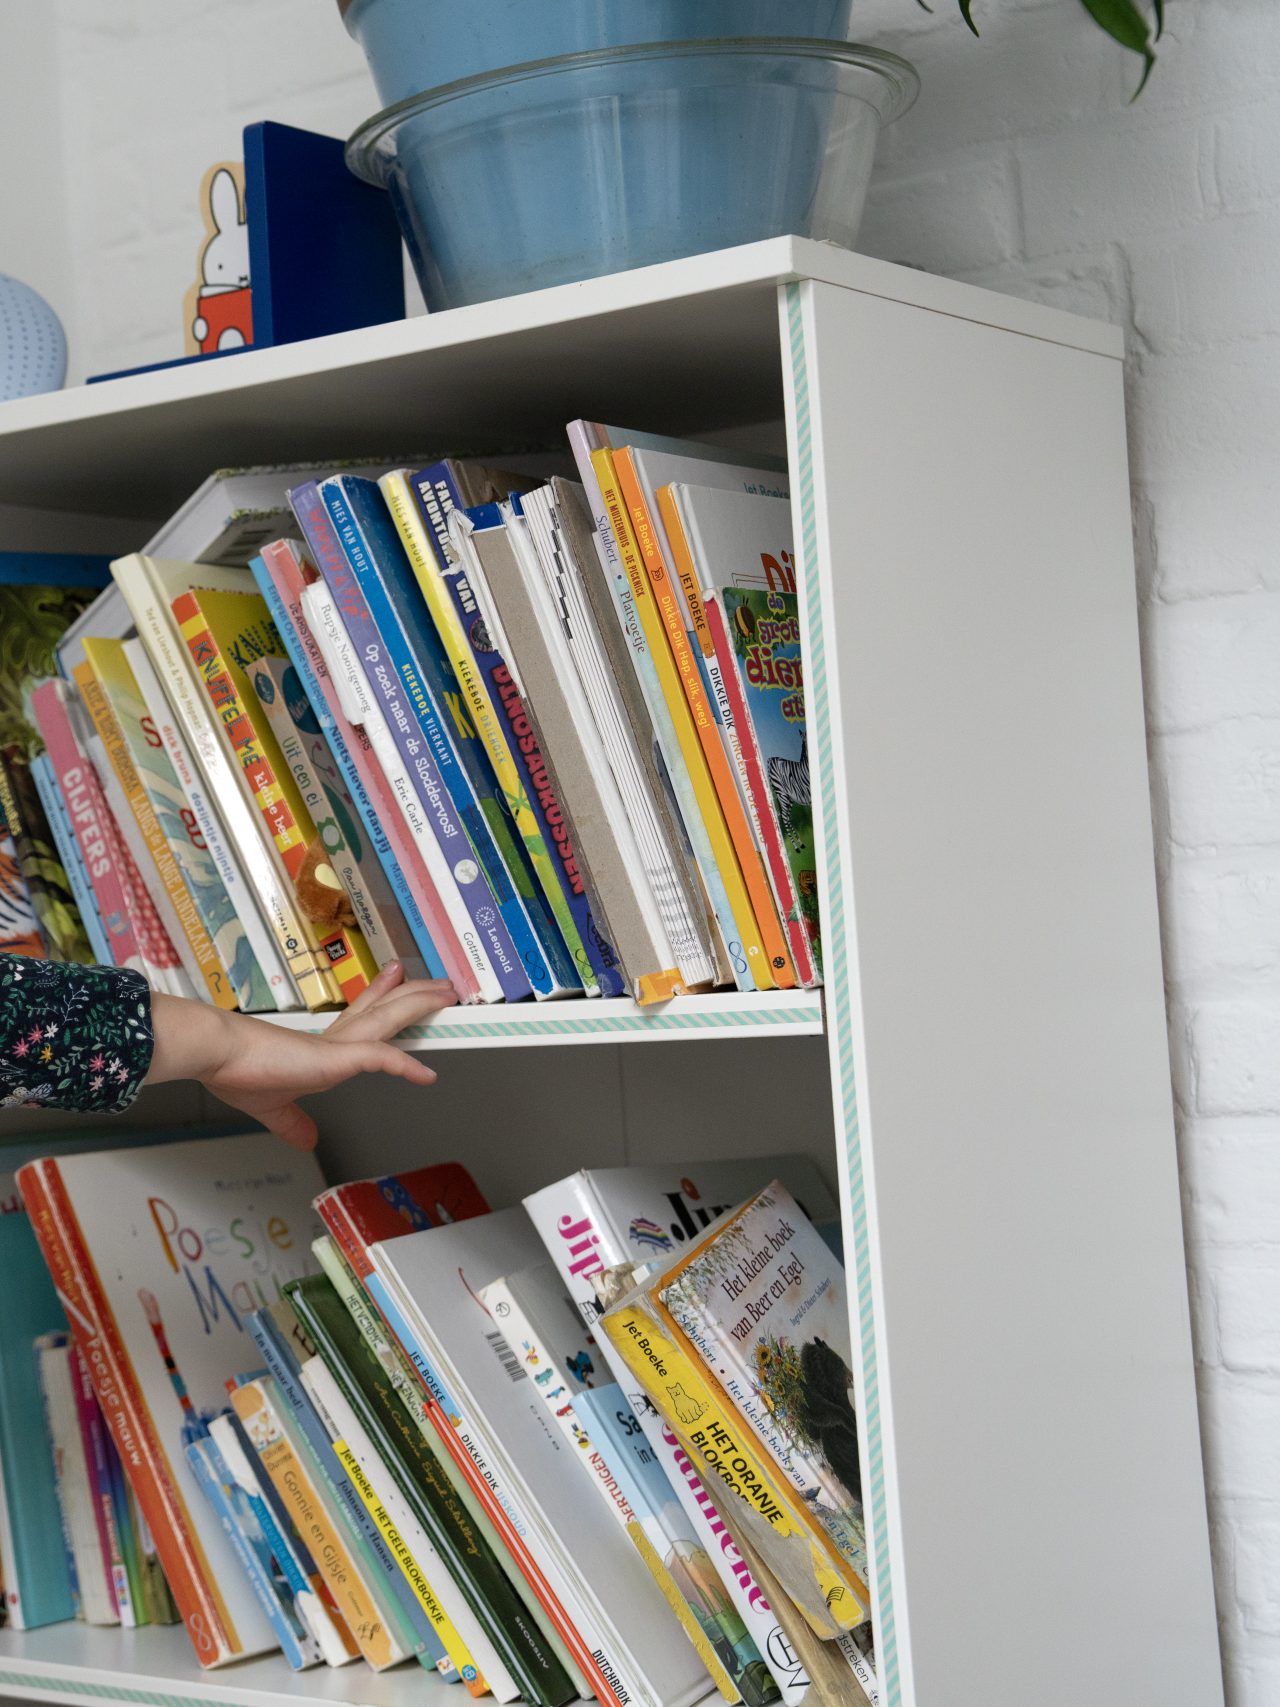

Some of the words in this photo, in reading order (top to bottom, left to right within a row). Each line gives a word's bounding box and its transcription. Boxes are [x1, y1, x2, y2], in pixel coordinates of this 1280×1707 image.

[434, 479, 455, 514] FAN
[603, 488, 616, 502] HET
[631, 505, 644, 523] Jet
[330, 499, 348, 523] MIES
[341, 524, 357, 545] VAN
[350, 546, 369, 573] HOUT
[389, 494, 407, 518] MIES
[400, 520, 416, 540] VAN
[408, 541, 427, 568] HOUT
[607, 503, 630, 547] MUIZENHUIS
[637, 523, 656, 557] Boeke
[595, 514, 620, 563] Schubert
[617, 590, 647, 654] Platvoetje
[624, 554, 634, 564] DE
[627, 564, 645, 597] PICKNICK
[452, 578, 477, 614] VAN
[659, 595, 679, 630] Dikkie
[679, 572, 693, 591] JET
[686, 592, 706, 630] BOEKE
[275, 605, 288, 622] van
[301, 663, 313, 680] van
[317, 603, 344, 643] Rupsje
[333, 642, 375, 714] Nooitgenoeg
[361, 642, 383, 665] Op
[671, 630, 686, 649] Dik
[758, 618, 800, 644] grot
[371, 663, 399, 699] zoek
[676, 650, 693, 676] Hap,
[685, 677, 701, 699] slik,
[189, 640, 248, 736] KNUFFEL
[234, 736, 261, 769] ME
[387, 700, 412, 735] naar
[400, 663, 430, 716] KIEKEBOE
[423, 717, 452, 766] VIERKANT
[457, 659, 485, 711] KIEKEBOE
[479, 713, 507, 765] DRIEHOEK
[691, 701, 710, 729] weg!
[708, 667, 728, 706] DIKKIE
[721, 708, 735, 729] DIK
[161, 723, 179, 749] dick
[172, 750, 194, 785] bruna
[279, 734, 303, 762] Uit
[291, 761, 313, 790] een
[305, 791, 322, 807] ei
[328, 725, 352, 764] Niets
[404, 735, 422, 755] de
[251, 771, 281, 815] kleine
[271, 815, 295, 846] beer
[345, 763, 371, 807] liever
[392, 776, 412, 802] Eric
[403, 801, 426, 834] Carle
[413, 756, 458, 839] Sloddervos!
[60, 766, 112, 878] CIJFERS
[188, 791, 219, 843] dozijntje
[211, 843, 237, 884] nijntje
[365, 807, 384, 836] dan
[374, 834, 391, 854] jij
[151, 844, 182, 888] LANGE
[170, 887, 215, 964] LINDELAAN
[350, 888, 381, 937] Morgan
[387, 862, 410, 896] Marije
[404, 894, 424, 928] Tolman
[461, 930, 488, 972] Gottmer
[484, 926, 515, 974] Leopold
[147, 1196, 295, 1276] Poesje
[557, 1214, 605, 1280] Jip
[717, 1271, 748, 1302] Het
[734, 1240, 775, 1282] kleine
[761, 1215, 797, 1252] boek
[766, 1278, 787, 1299] en
[774, 1251, 808, 1288] Egel
[729, 1316, 755, 1342] van
[742, 1288, 776, 1323] Beer
[253, 1332, 267, 1348] En
[261, 1347, 274, 1362] nu
[270, 1362, 288, 1386] naar
[283, 1385, 304, 1411] bed!
[408, 1350, 424, 1369] JET
[420, 1369, 446, 1403] BOEKE
[622, 1318, 644, 1340] Jet
[637, 1337, 670, 1378] Boeke
[80, 1336, 122, 1409] Poesje
[112, 1410, 143, 1466] mauw
[678, 1312, 718, 1364] Schubert
[725, 1378, 745, 1401] Het
[741, 1400, 772, 1438] kleine
[767, 1436, 792, 1466] boek
[787, 1466, 806, 1487] van
[833, 1529, 859, 1559] Egel
[460, 1433, 487, 1470] DIKKIE
[483, 1470, 499, 1490] DIK
[495, 1491, 528, 1537] IJSKOUD
[705, 1419, 738, 1459] HET
[729, 1454, 783, 1526] ORANJE
[280, 1469, 317, 1522] Gonnie
[309, 1523, 326, 1543] en
[318, 1542, 351, 1586] Gijsje
[337, 1478, 369, 1522] Johnson
[367, 1530, 397, 1572] Hansen
[340, 1447, 357, 1466] Jet
[350, 1463, 376, 1499] Boeke
[373, 1505, 392, 1529] HET
[386, 1528, 407, 1556] GELE
[401, 1555, 444, 1625] BLOKBOEKJE
[513, 1615, 549, 1670] SKOGSLIV
[591, 1647, 631, 1707] DUTCHBOOK
